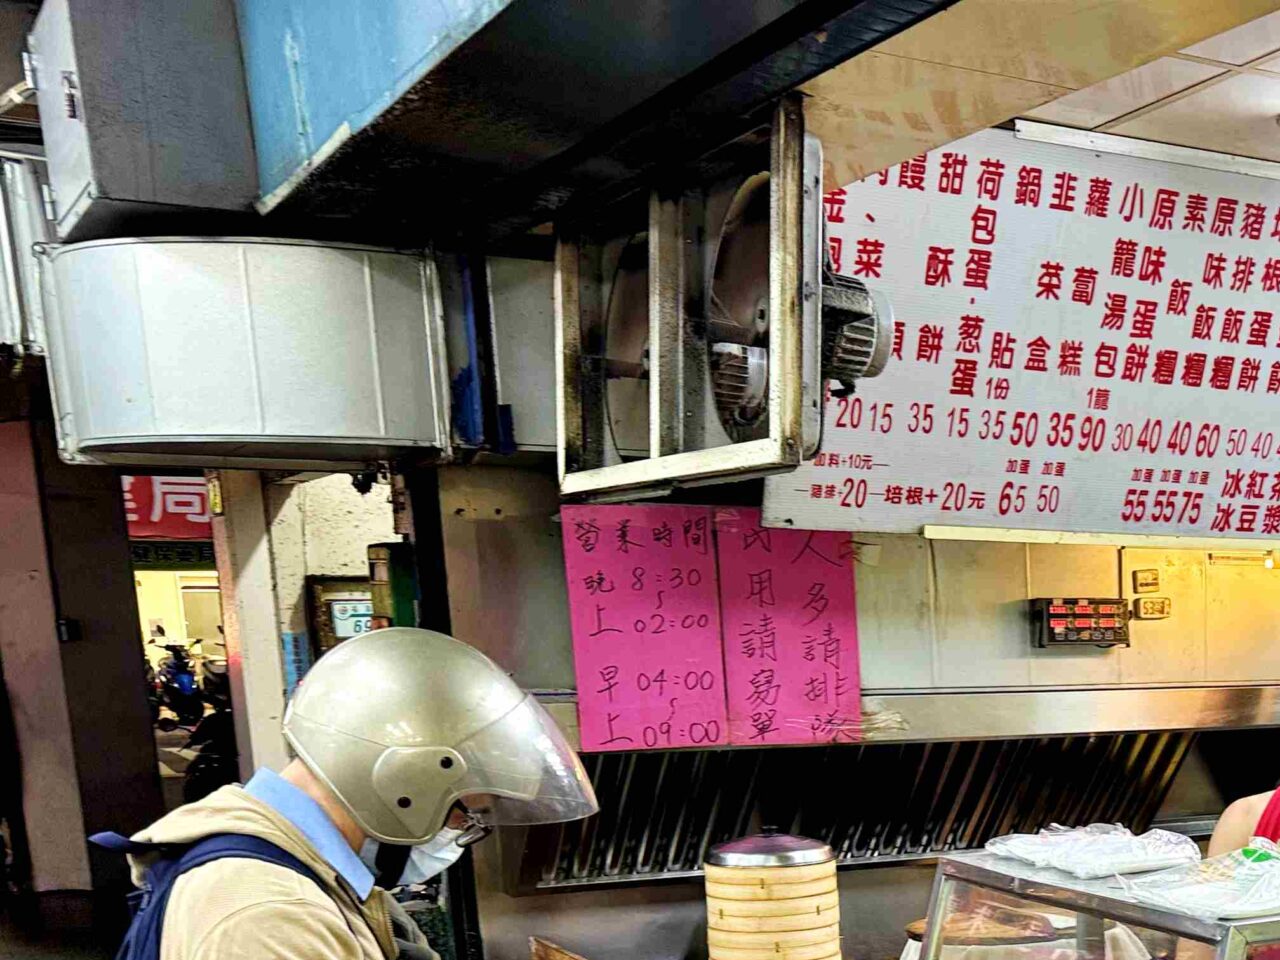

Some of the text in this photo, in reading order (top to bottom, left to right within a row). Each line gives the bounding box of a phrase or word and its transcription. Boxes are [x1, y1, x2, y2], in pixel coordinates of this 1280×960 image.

[916, 152, 968, 364] 甜酥餅
[1024, 172, 1077, 372] 韭菜盒
[1057, 177, 1112, 376] 蘿蔔糕
[1094, 183, 1144, 378] 小籠湯包
[1120, 189, 1180, 382] 原味蛋餅
[836, 398, 862, 429] 20
[870, 403, 894, 433] 15
[908, 403, 934, 433] 35
[947, 408, 970, 437] 15
[979, 410, 1006, 440] 35
[1010, 412, 1038, 447] 50
[1046, 412, 1076, 447] 35
[1078, 416, 1106, 452] 90
[1112, 424, 1133, 451] 30
[1137, 418, 1162, 453] 40
[1167, 420, 1192, 456] 40
[1195, 423, 1220, 458] 60
[1226, 429, 1247, 456] 50
[1251, 432, 1273, 459] 40
[121, 475, 211, 522] 局
[998, 481, 1060, 515] 65 50
[1121, 489, 1204, 525] 55 55 75
[575, 516, 708, 555] 營業時間
[631, 567, 701, 591] 8:30
[634, 614, 709, 634] 02:00
[637, 669, 714, 696] 04:00
[643, 720, 720, 748] 09:00
